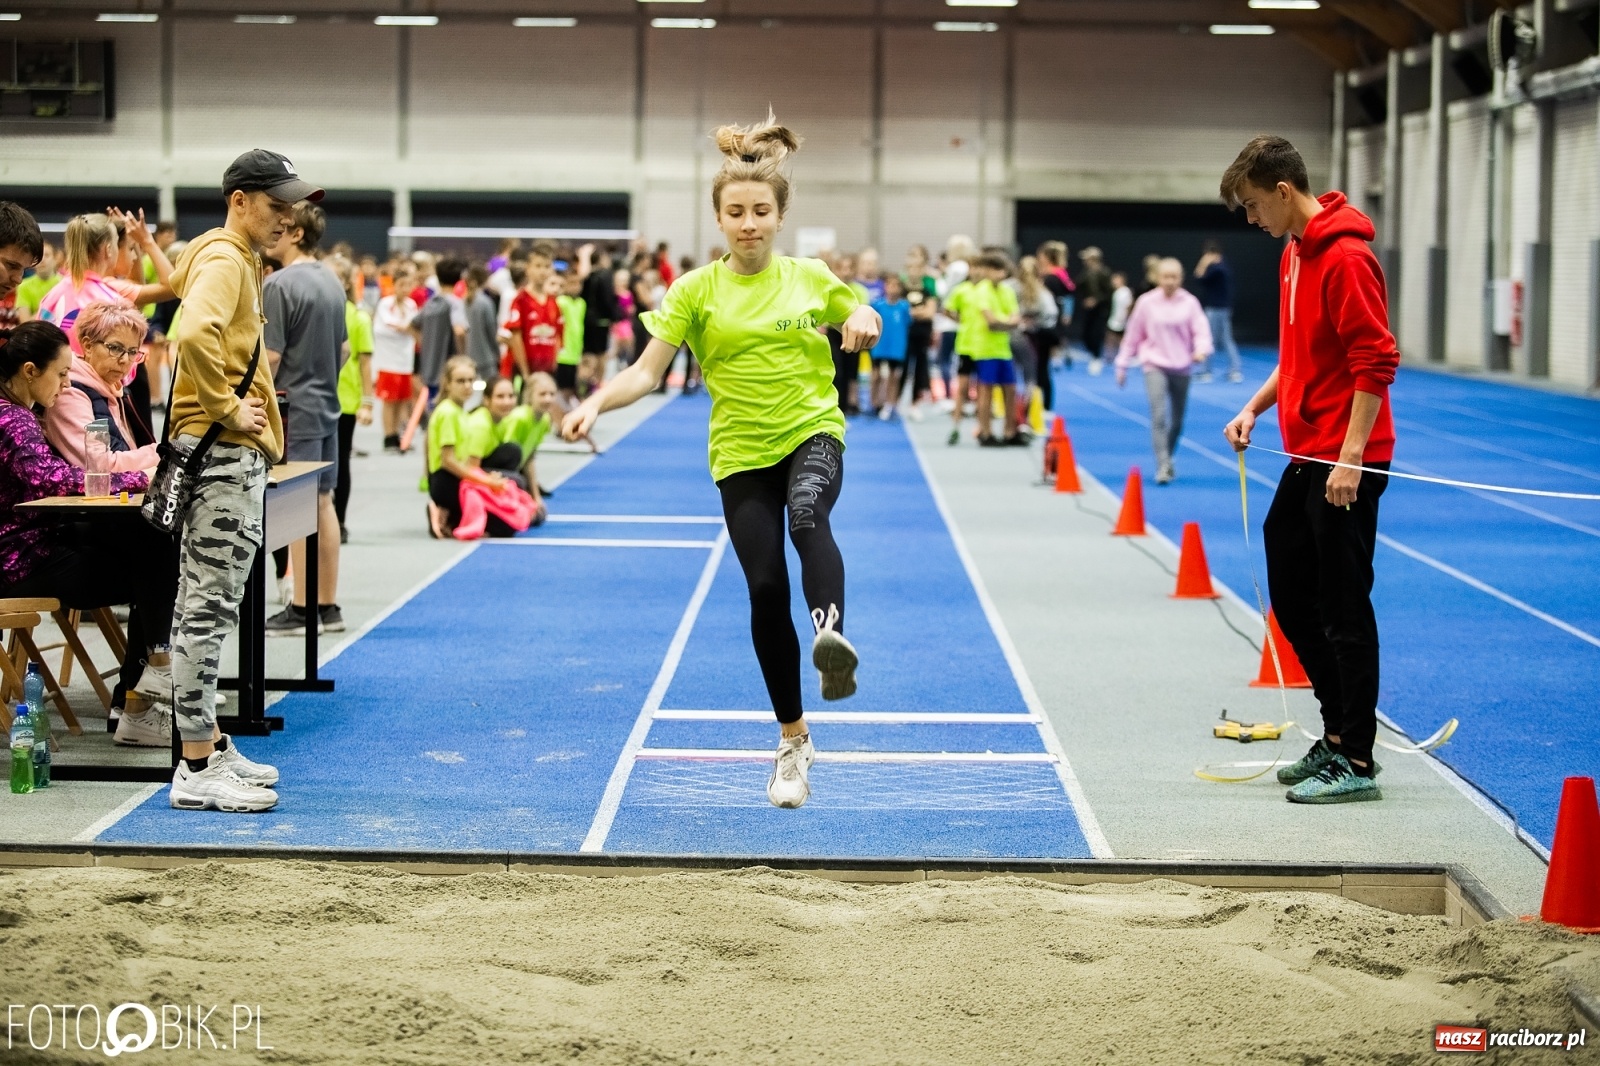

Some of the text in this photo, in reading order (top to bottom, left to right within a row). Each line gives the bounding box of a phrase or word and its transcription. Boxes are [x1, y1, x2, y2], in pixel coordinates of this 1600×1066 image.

[775, 319, 792, 332] SP
[796, 317, 808, 330] 18
[162, 466, 185, 526] adida
[788, 432, 840, 532] TART NOW
